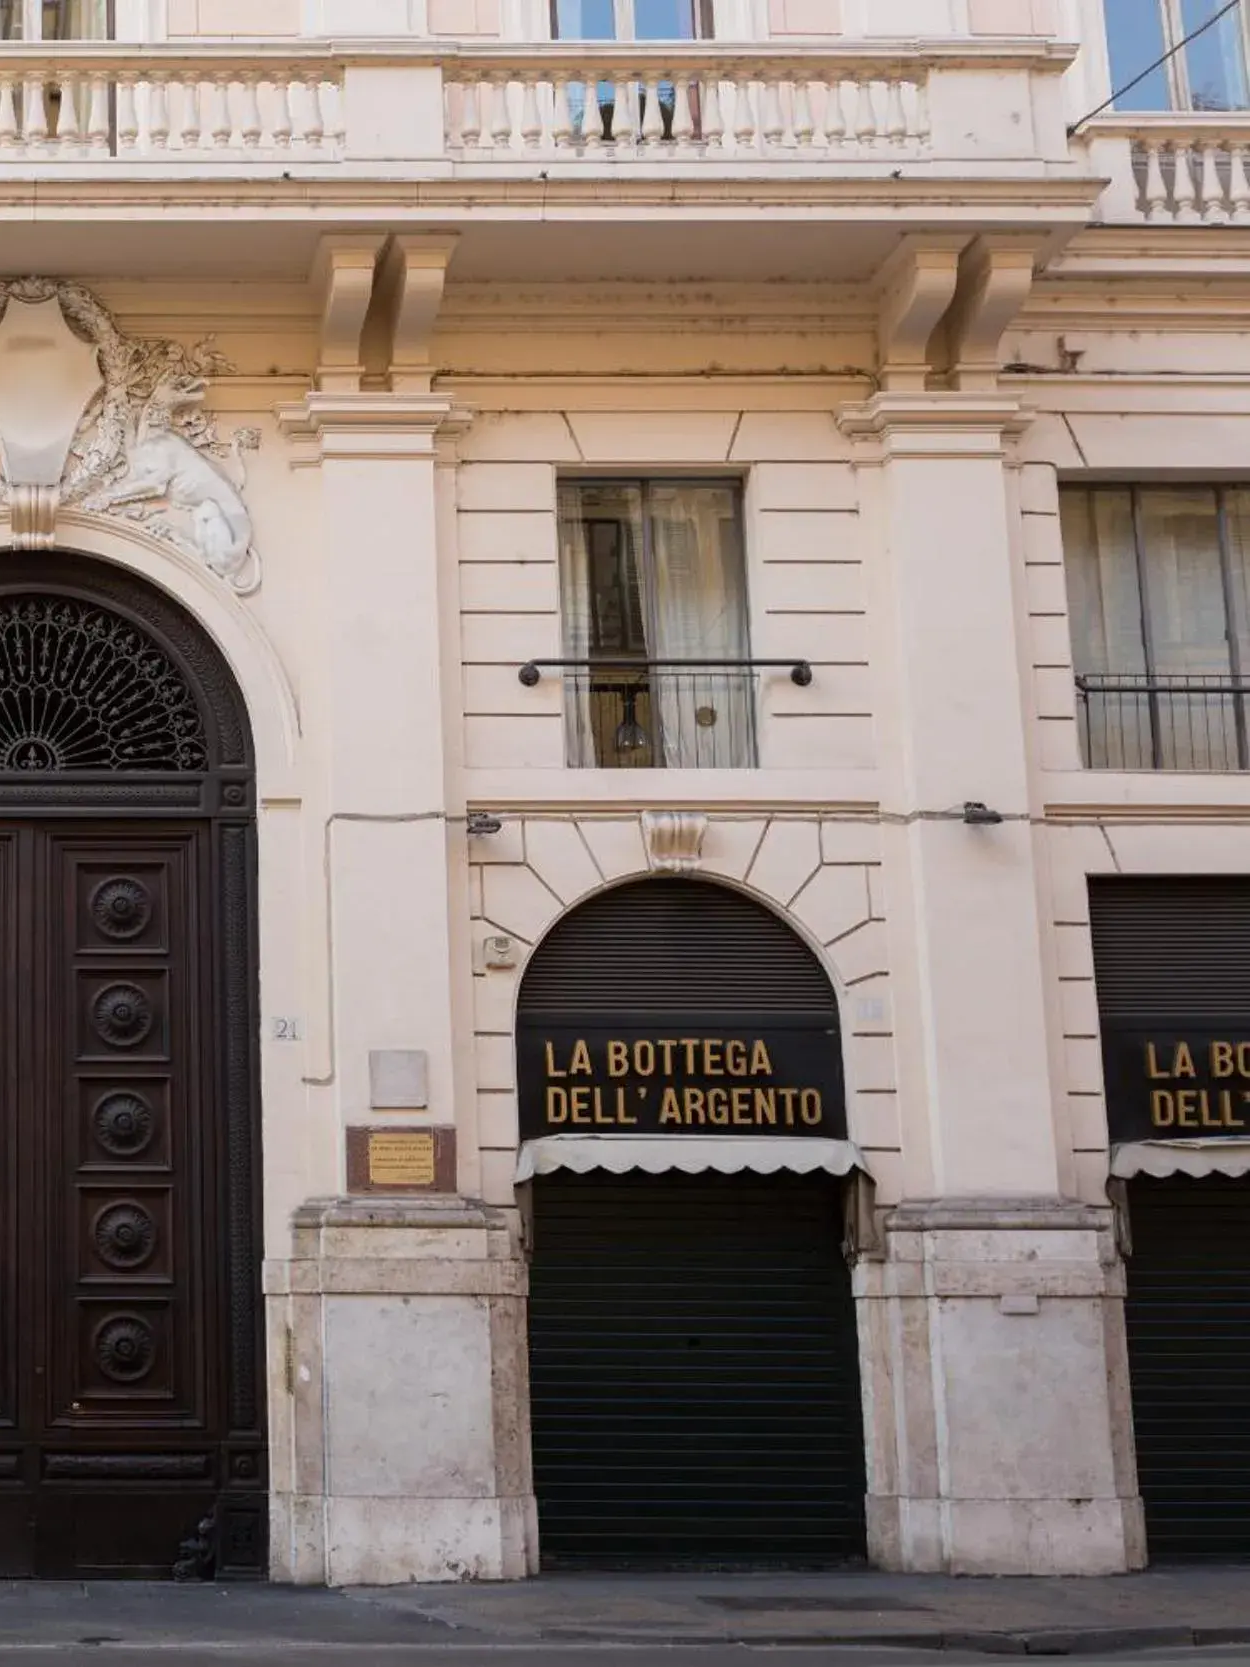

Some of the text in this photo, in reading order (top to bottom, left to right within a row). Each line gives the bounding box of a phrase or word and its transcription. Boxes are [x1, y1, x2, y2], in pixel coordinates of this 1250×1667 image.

[276, 1019, 297, 1038] 21
[545, 1039, 773, 1077] LA BOTTEGA
[1148, 1041, 1196, 1078] LA
[546, 1086, 822, 1125] DELL' ARGENTO
